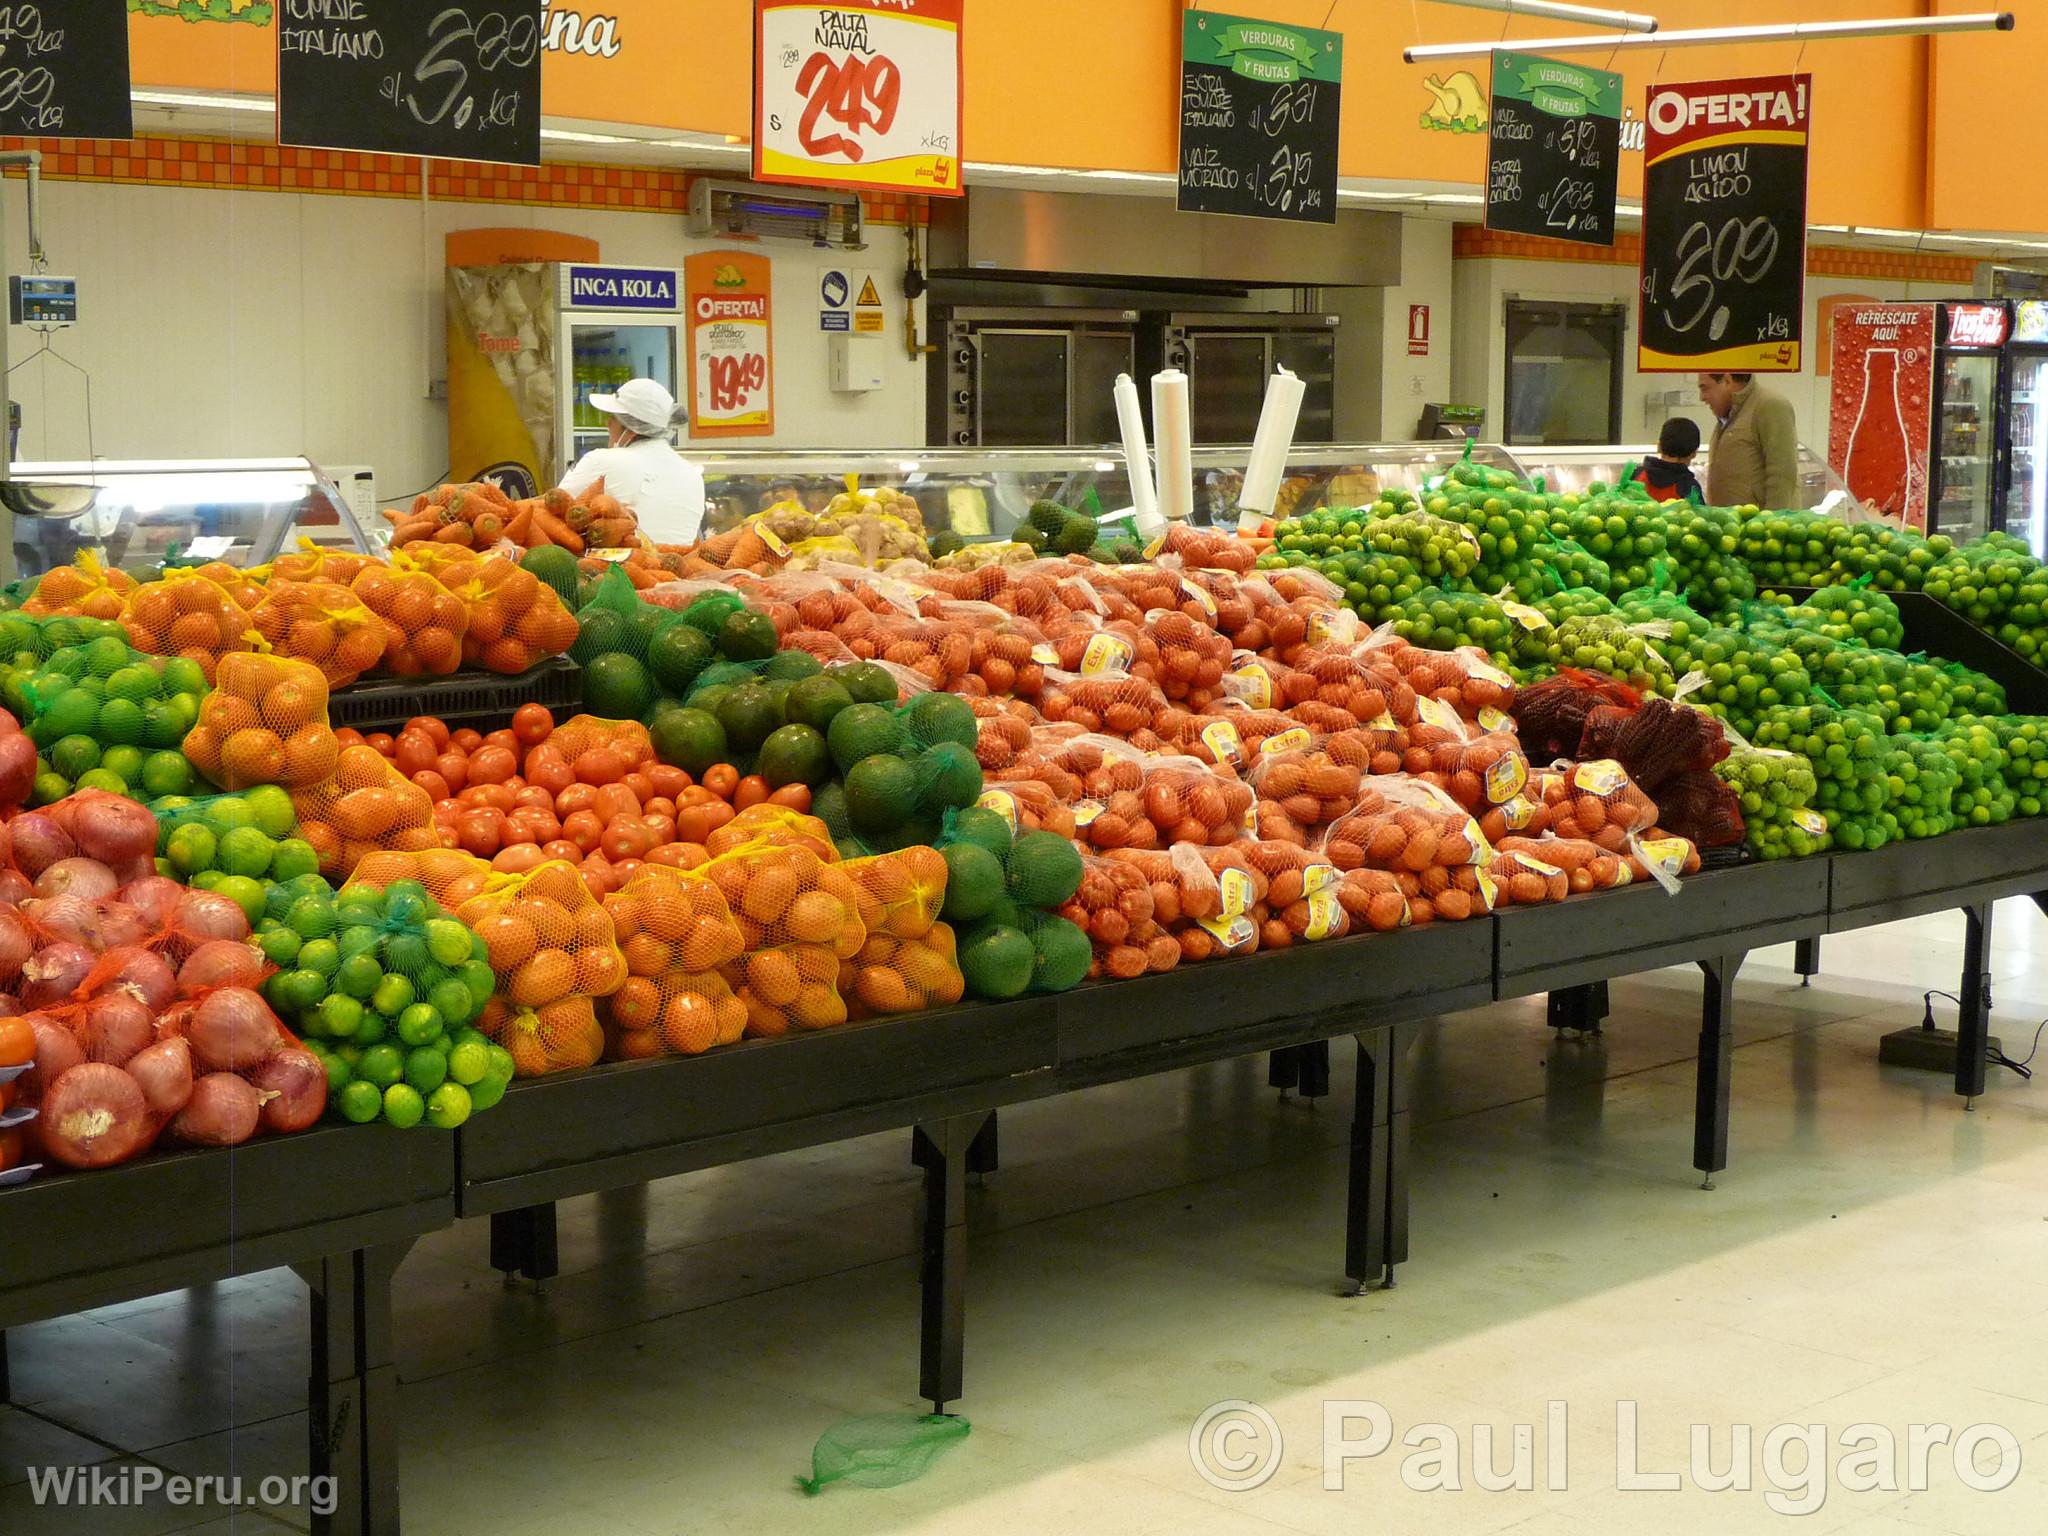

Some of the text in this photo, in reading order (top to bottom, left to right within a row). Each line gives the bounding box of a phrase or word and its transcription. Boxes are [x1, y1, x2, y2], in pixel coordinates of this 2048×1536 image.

[819, 10, 868, 34] PALTA
[814, 28, 876, 56] NAVAL
[1239, 30, 1296, 52] VERDURAS
[1243, 61, 1291, 80] Y FRUTAS
[1538, 68, 1585, 89] VERDURAS
[1541, 95, 1580, 113] Y FRUTAS
[1648, 83, 1806, 135] OFERTA!
[1690, 147, 1749, 180] LIMON
[1684, 173, 1752, 204] ACIDO
[573, 277, 671, 299] INCA KOLA
[697, 297, 765, 319] OFERTA!
[1855, 312, 1919, 326] REFRESCATE
[479, 332, 521, 352] Tome
[1272, 734, 1301, 751] Extra
